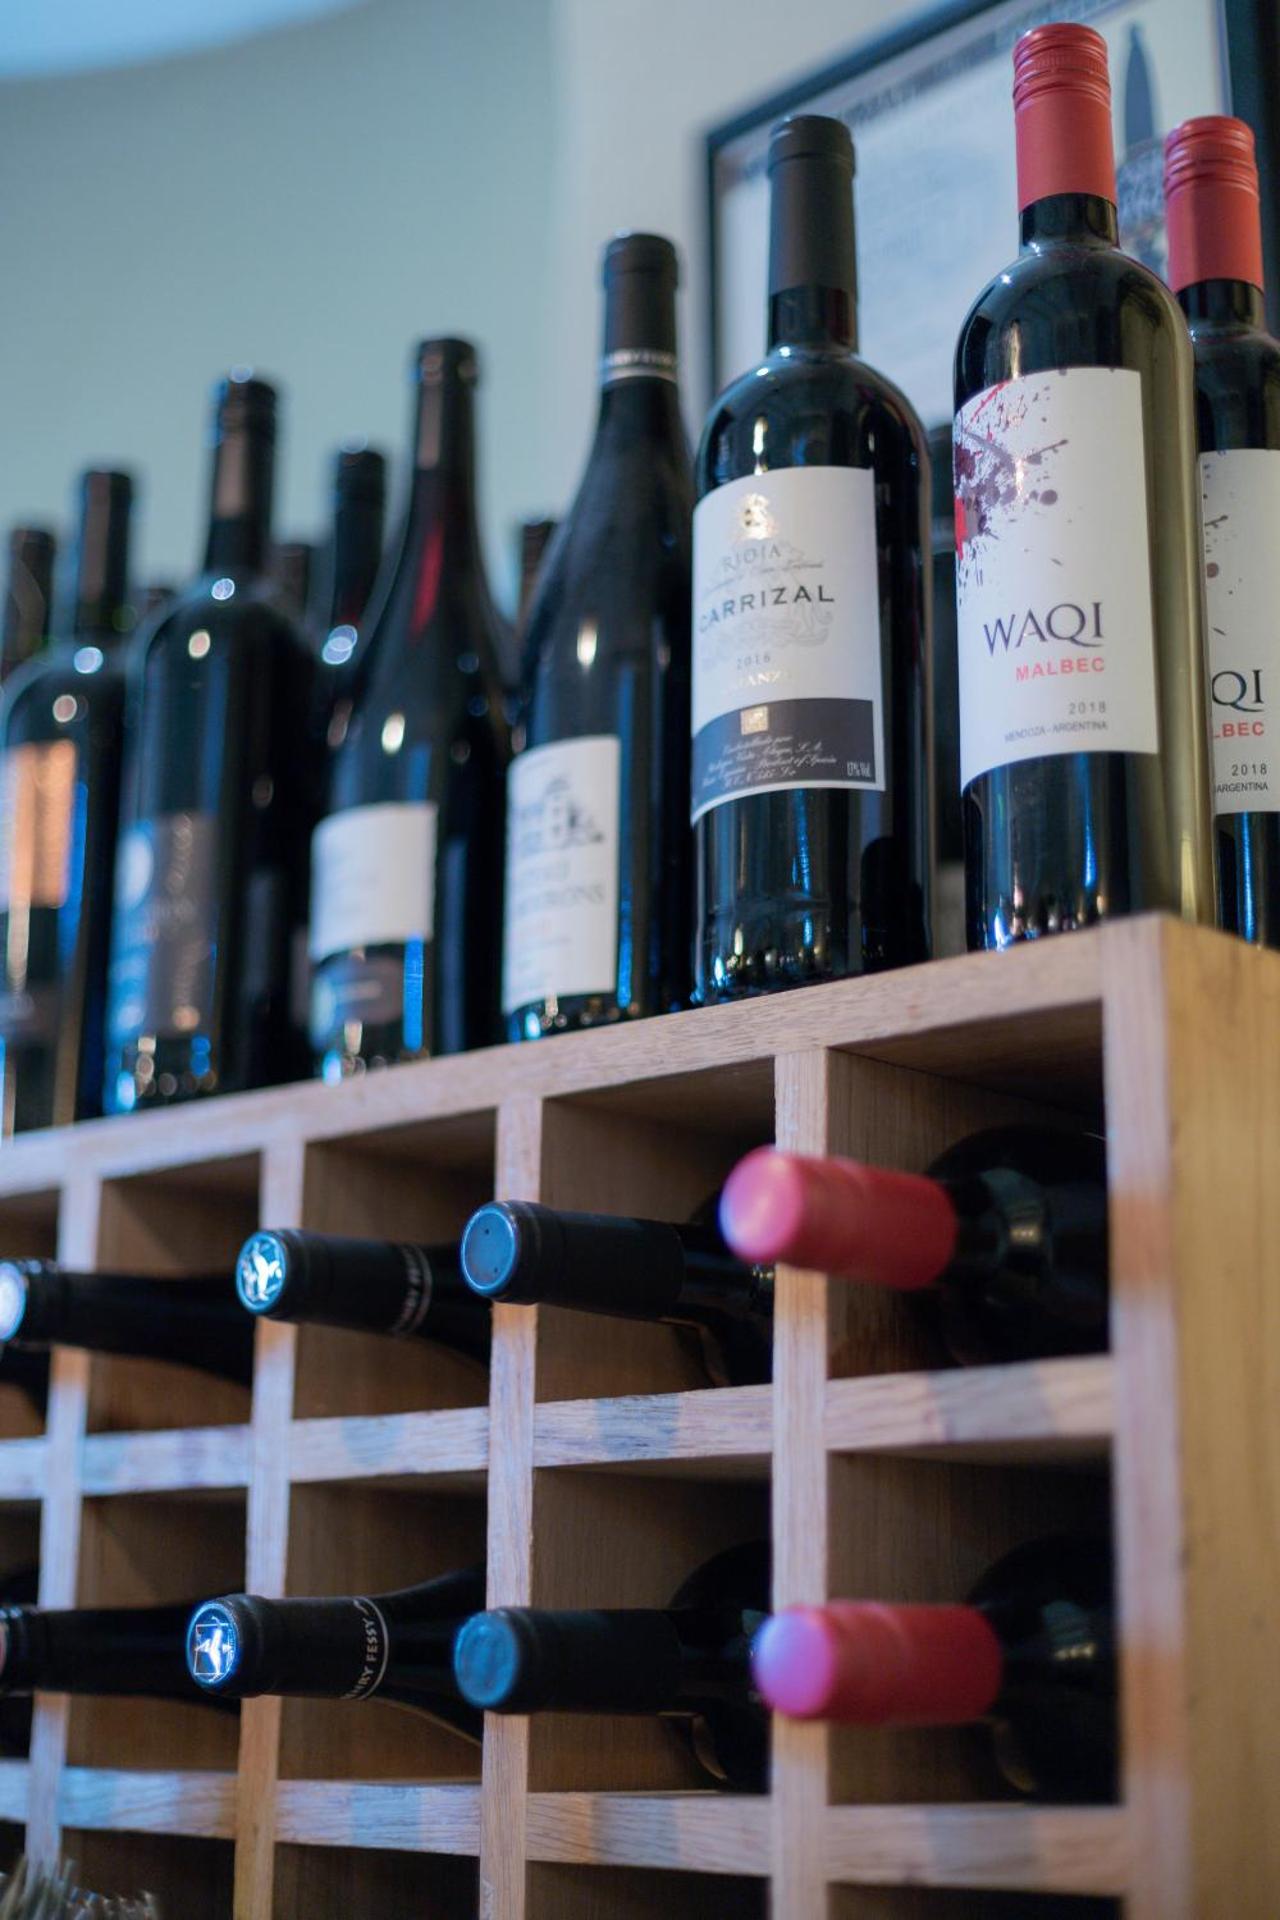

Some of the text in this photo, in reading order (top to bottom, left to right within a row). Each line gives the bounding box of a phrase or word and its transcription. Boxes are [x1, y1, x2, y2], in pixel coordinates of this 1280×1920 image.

[698, 585, 835, 634] CARRIZAL
[983, 601, 1105, 656] WAQI
[1015, 657, 1106, 682] MALBEC
[1211, 669, 1265, 712] QI
[1068, 700, 1107, 716] 2018
[1052, 720, 1109, 734] ARGENTINA
[1212, 721, 1265, 739] BEC
[1231, 763, 1268, 777] 2018
[1216, 781, 1269, 793] ARGENTINA
[362, 1617, 378, 1662] FESSY
